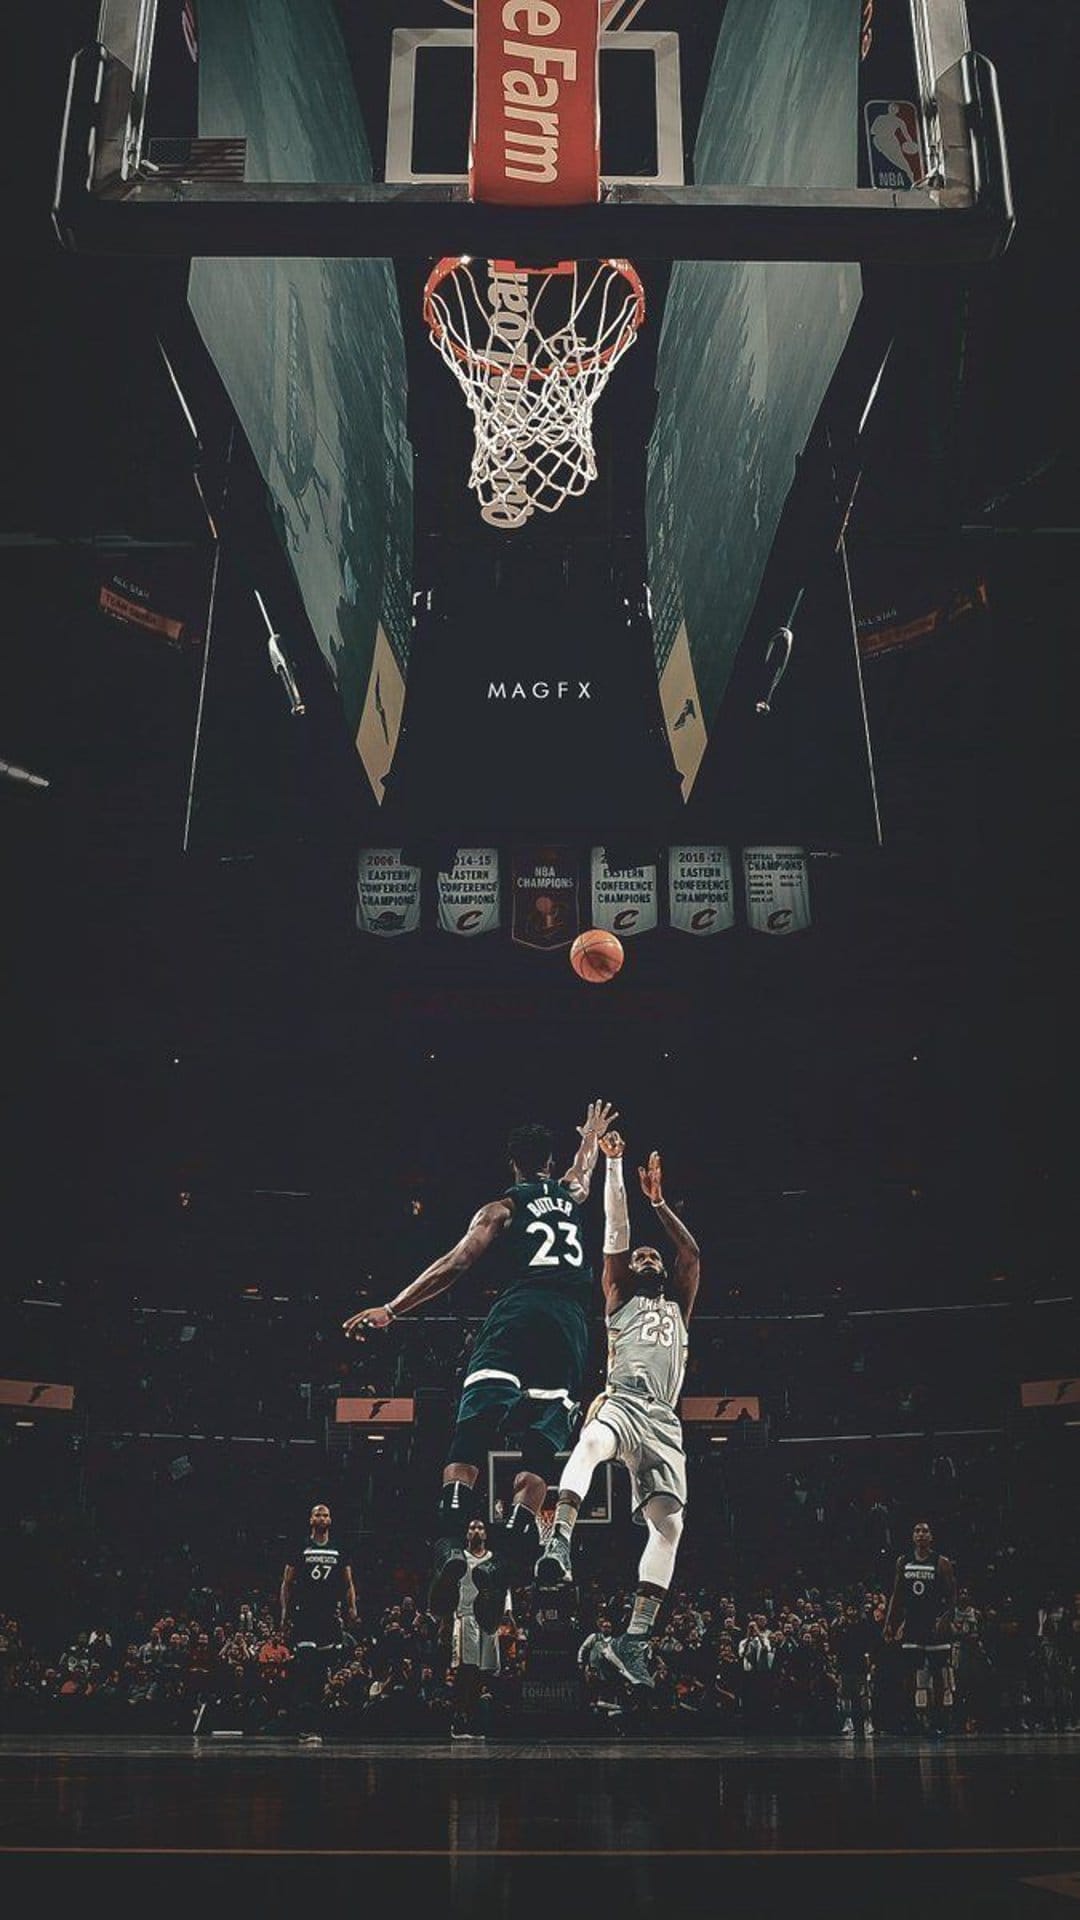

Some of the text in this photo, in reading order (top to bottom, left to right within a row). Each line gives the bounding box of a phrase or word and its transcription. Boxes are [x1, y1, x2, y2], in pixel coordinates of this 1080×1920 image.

[879, 172, 905, 187] NBA
[368, 869, 411, 881] EASTERN
[534, 866, 556, 878] NBA
[681, 867, 721, 878] EASTERN
[359, 882, 417, 893] CONFERENCE
[441, 882, 498, 893] CONFERENCE
[517, 877, 575, 889] CHAMPIONS
[595, 880, 654, 891] CONFERENCE
[673, 879, 730, 891] CONFERENCE
[362, 894, 416, 906] CHAMPIONS
[443, 894, 496, 905] CHAMPIONS
[598, 892, 651, 904] CHAMPIONS
[675, 891, 729, 903] CHAMPIONS
[526, 1196, 574, 1218] BUTLER
[525, 1220, 584, 1267] 23
[639, 1309, 676, 1348] 23
[311, 1564, 332, 1581] 67
[912, 1580, 926, 1596] 0
